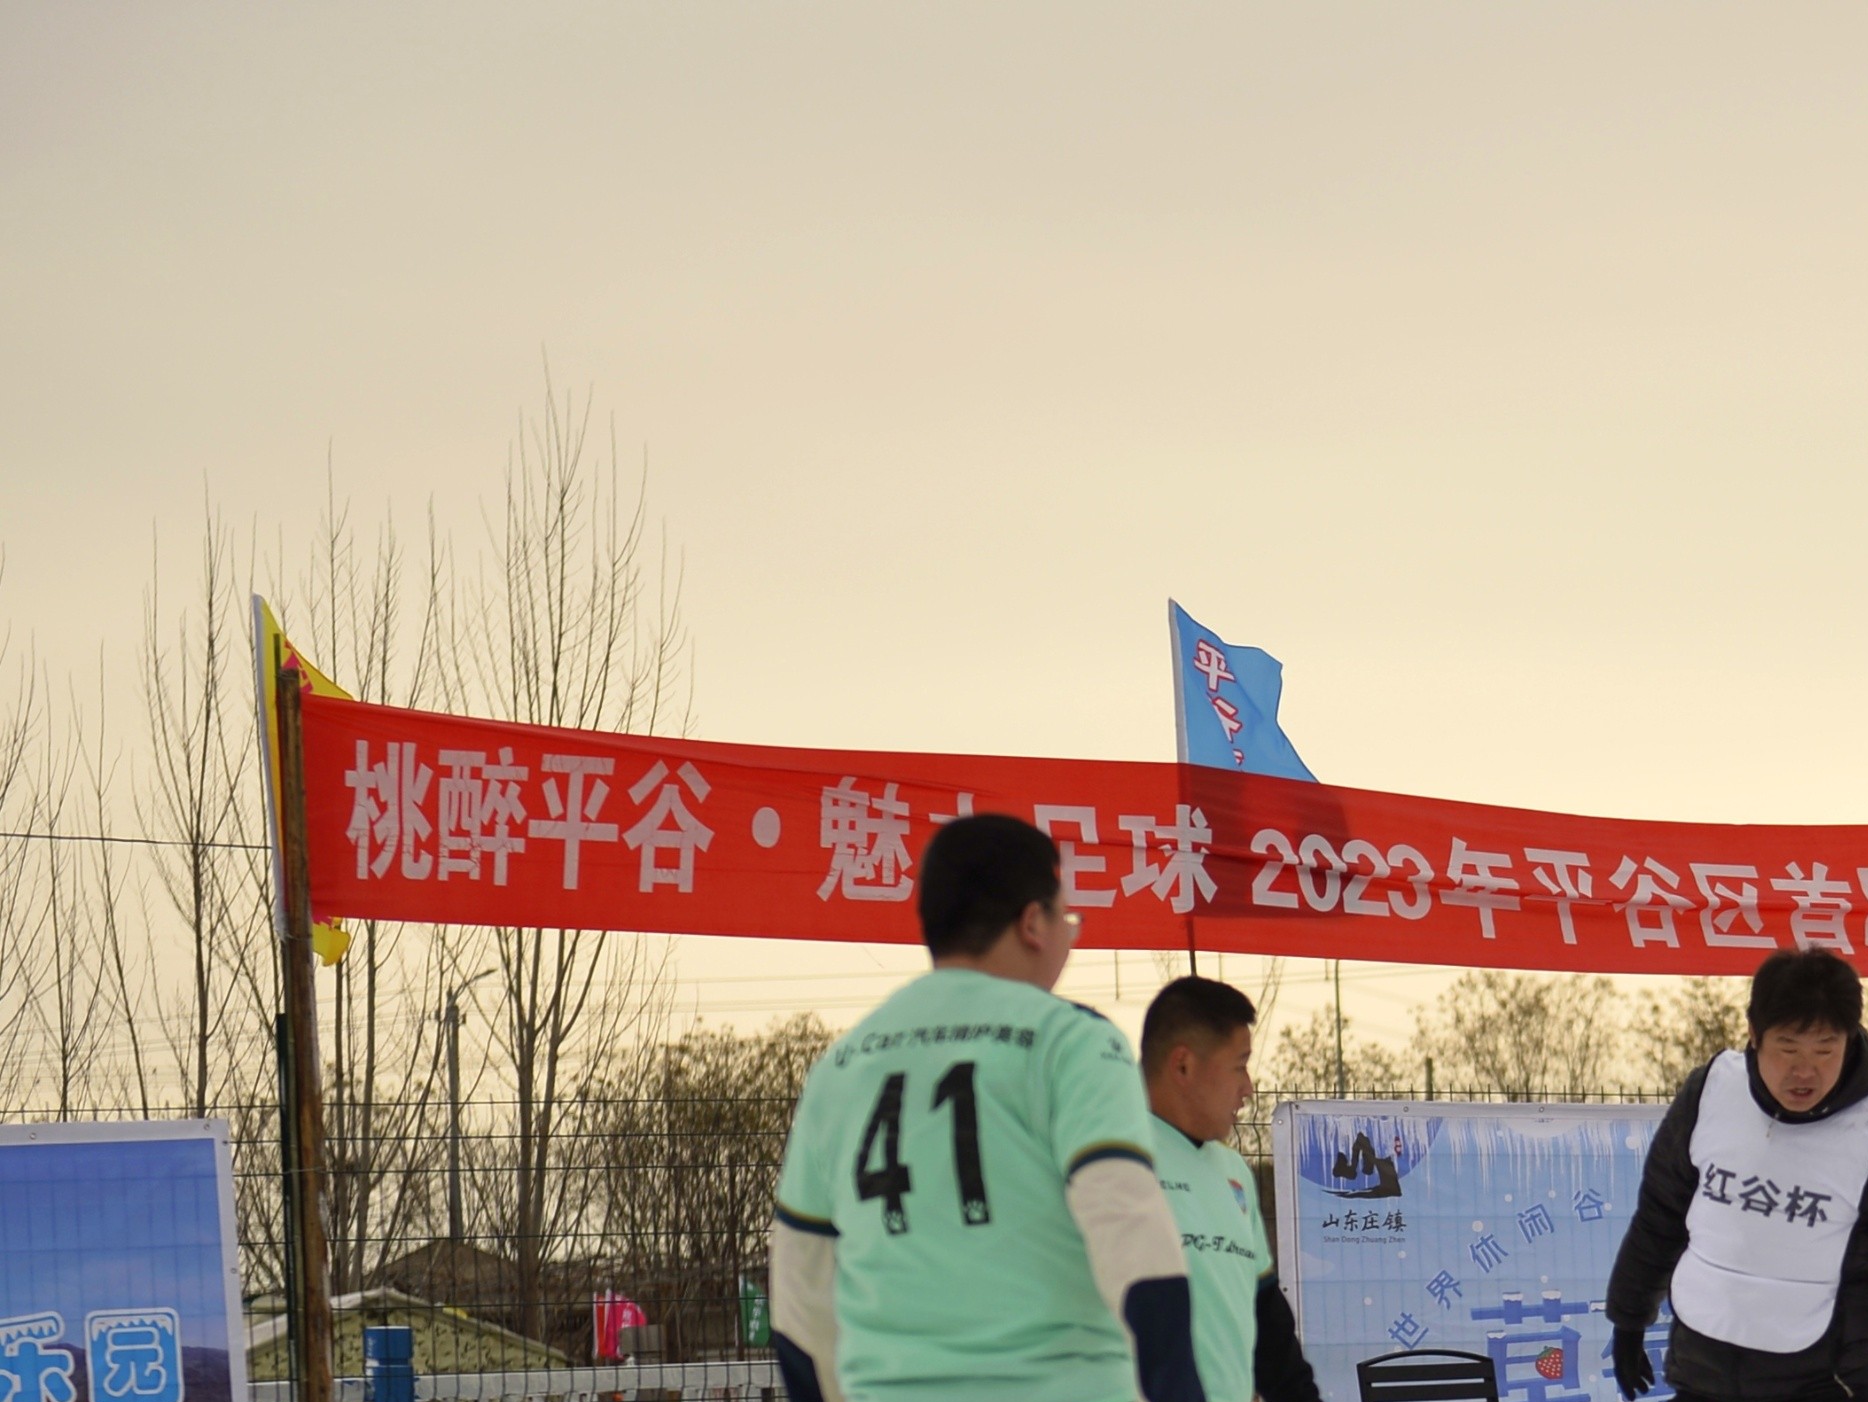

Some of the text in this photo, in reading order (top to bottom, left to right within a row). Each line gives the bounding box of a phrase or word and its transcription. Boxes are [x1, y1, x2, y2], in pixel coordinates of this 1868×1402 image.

[345, 739, 1218, 914] 桃醉平谷·魅足球
[855, 1061, 991, 1235] 41
[1702, 1162, 1832, 1228] 红谷杯
[1322, 1208, 1407, 1233] 山东庄镇
